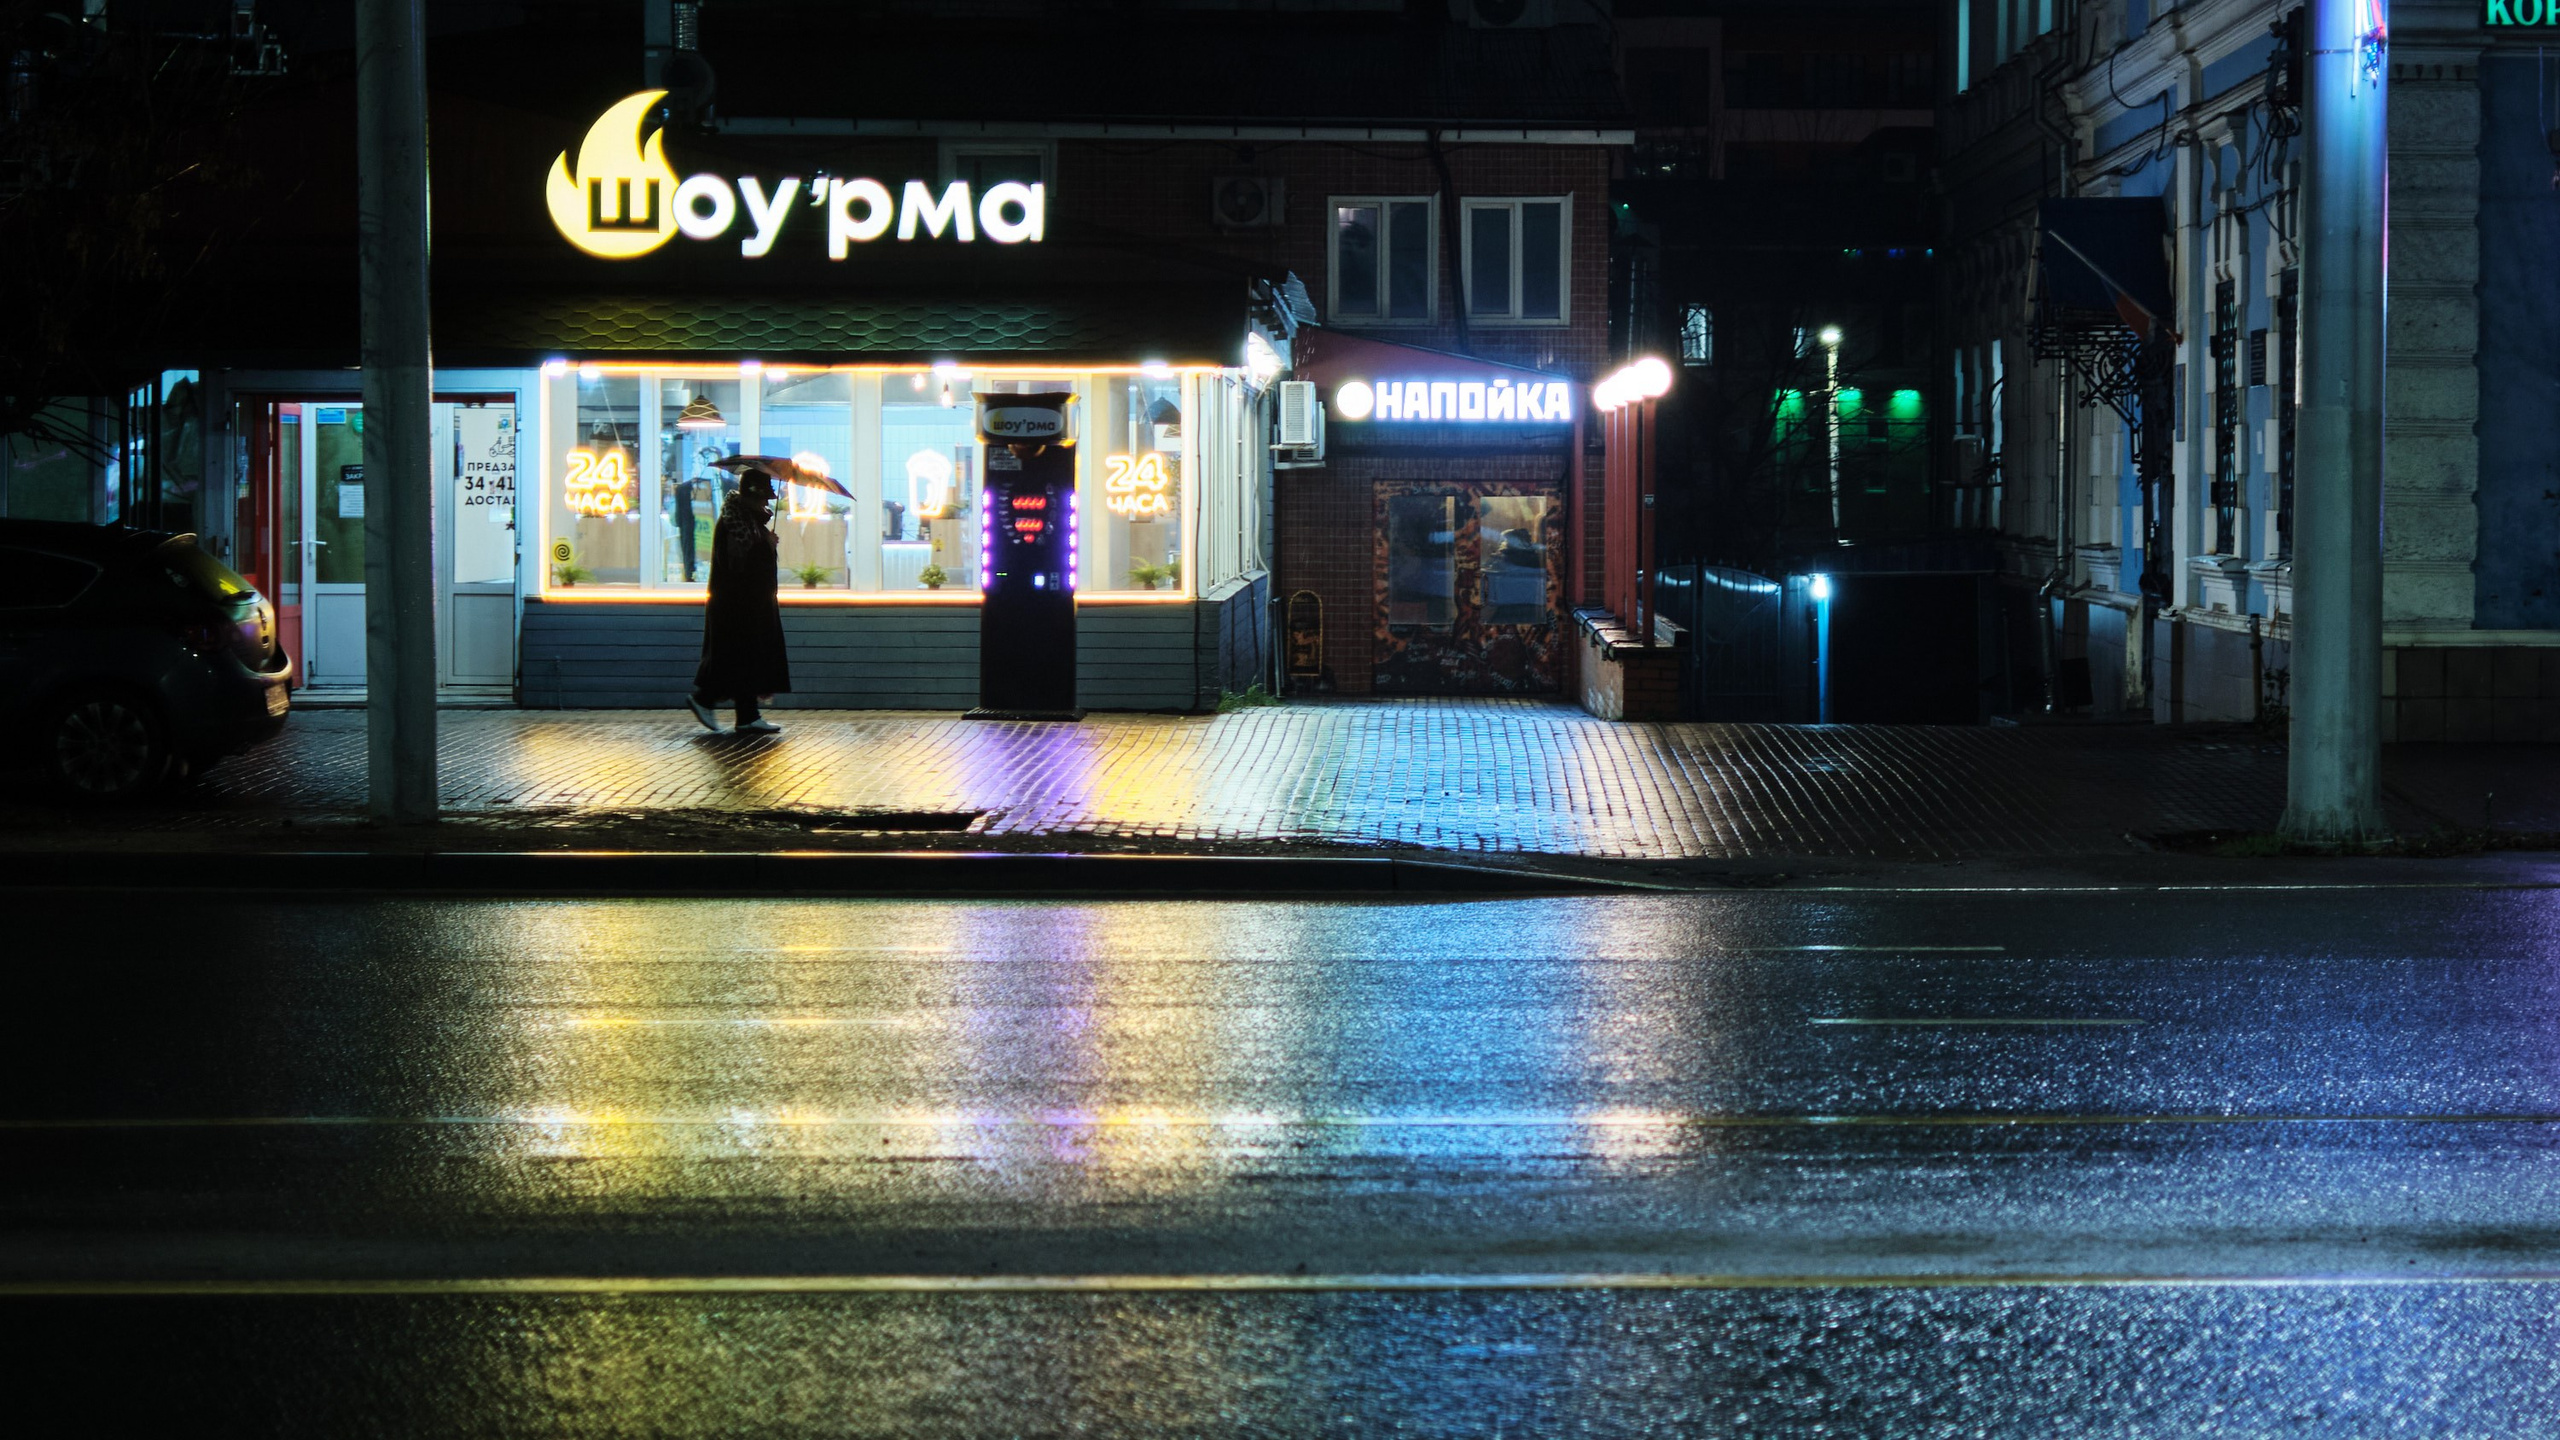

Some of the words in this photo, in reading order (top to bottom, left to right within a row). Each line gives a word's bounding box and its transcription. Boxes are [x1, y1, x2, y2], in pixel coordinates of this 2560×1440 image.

[1375, 379, 1571, 419] НАПОЙКА
[565, 451, 629, 489] 24
[1105, 453, 1168, 492] 24
[564, 491, 629, 515] ЧАСА
[1106, 493, 1169, 514] ЧАСА
